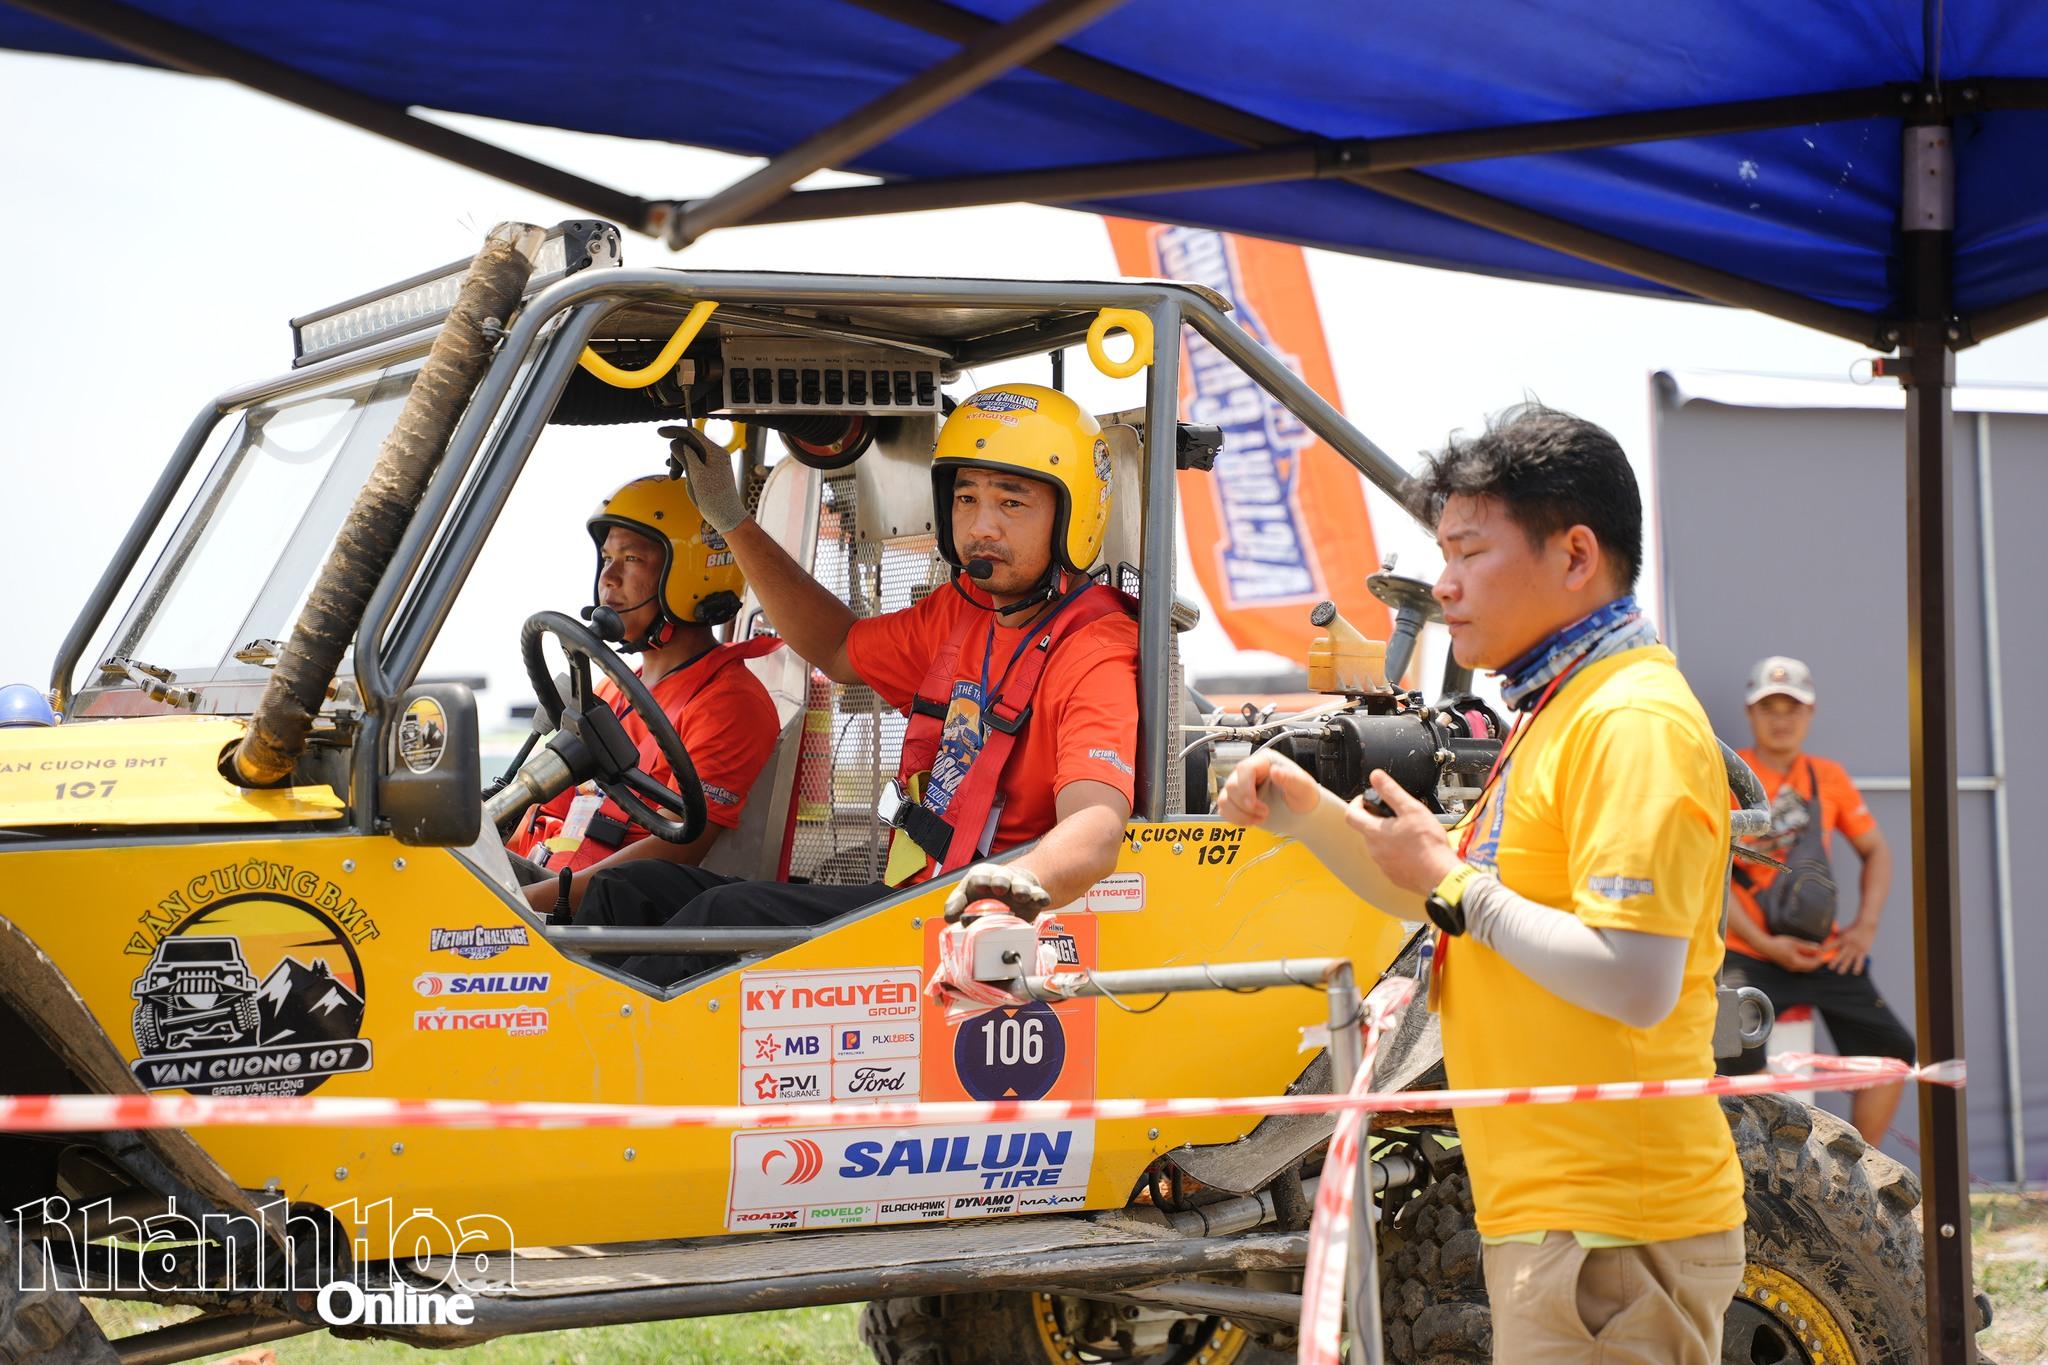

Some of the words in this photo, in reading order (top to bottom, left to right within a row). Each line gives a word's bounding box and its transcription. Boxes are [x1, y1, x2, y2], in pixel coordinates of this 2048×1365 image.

[0, 762, 32, 773] AN
[40, 759, 118, 771] CUONG
[125, 757, 168, 768] BMT
[55, 780, 118, 800] 107
[1141, 828, 1205, 842] CUONG
[1209, 827, 1246, 842] BMT
[1198, 845, 1240, 865] 107
[315, 881, 380, 945] BMT
[475, 926, 529, 946] CHALLENGE
[449, 976, 548, 993] SAILUN
[868, 1006, 917, 1017] GROUP
[510, 1028, 547, 1037] GROUP
[785, 1036, 820, 1056] MB
[981, 1018, 1044, 1066] 106
[150, 1061, 202, 1084] VAN
[208, 1052, 302, 1080] CUONG
[309, 1048, 353, 1070] 107
[779, 1075, 817, 1091] PVI
[848, 1067, 906, 1093] Ford
[212, 1085, 242, 1096] GARA
[779, 1089, 821, 1099] INSURANCE
[839, 1131, 1073, 1178] SAILUN
[980, 1168, 1062, 1190] TIRE
[881, 1200, 946, 1213] BLACKHAWK
[954, 1194, 1014, 1208] DYNAMO
[1020, 1195, 1086, 1206] MAXAM
[736, 1210, 799, 1222] ROADX
[811, 1206, 864, 1218] ROVELO
[986, 1206, 1010, 1214] TIRE
[769, 1221, 797, 1229] TIRE
